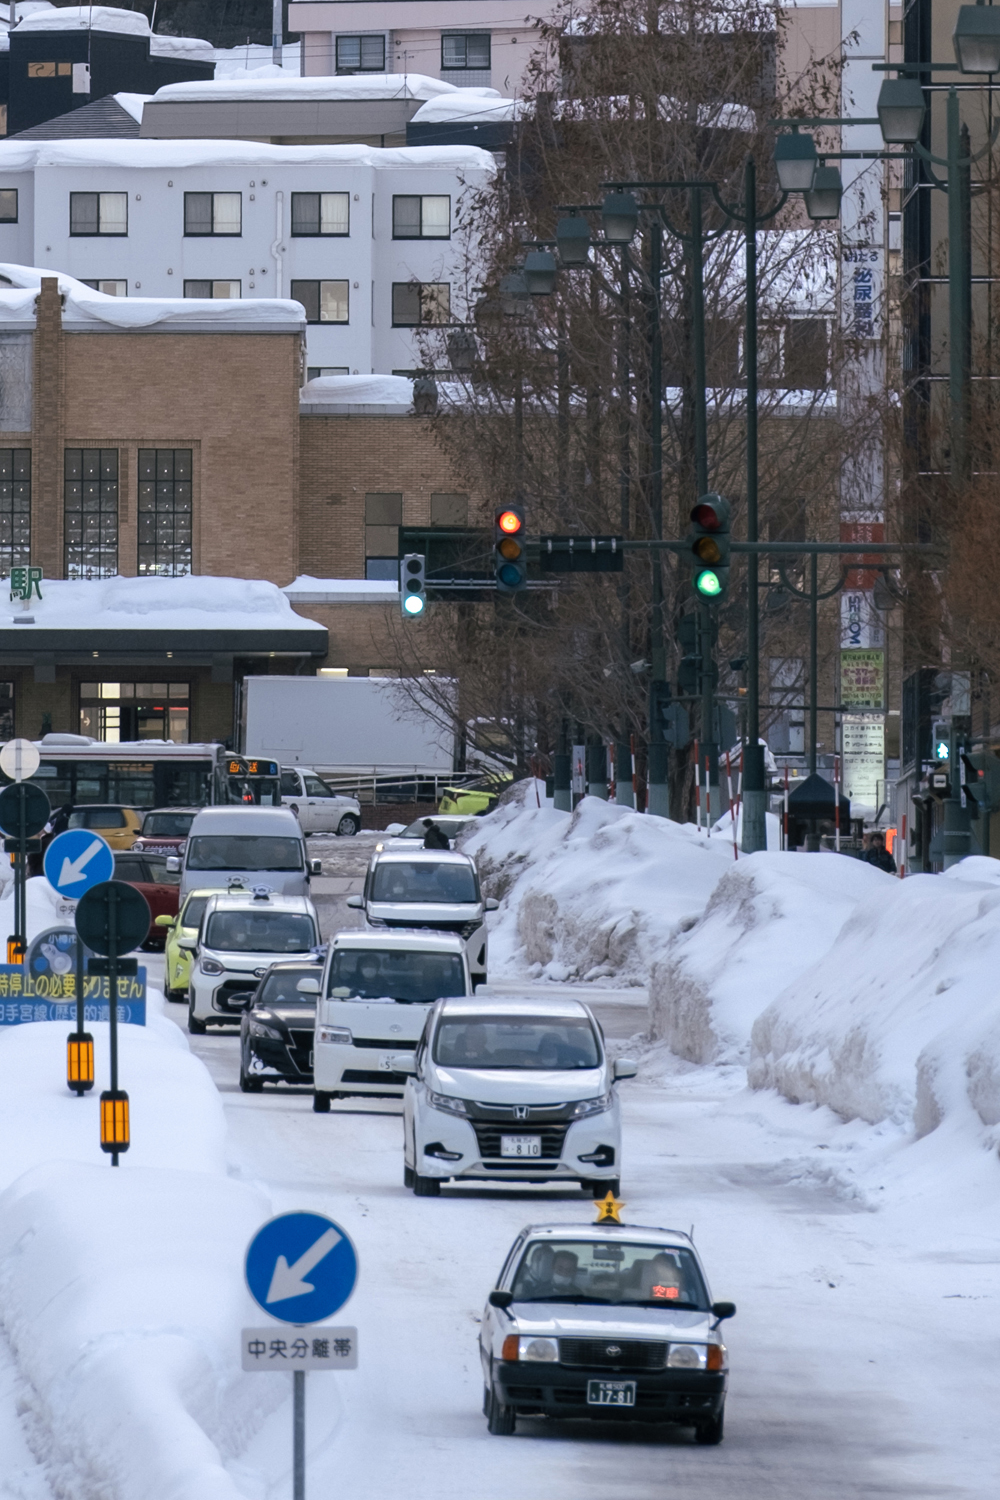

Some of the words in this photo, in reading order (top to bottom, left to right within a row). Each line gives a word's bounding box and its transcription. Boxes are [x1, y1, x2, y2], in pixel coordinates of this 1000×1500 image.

[652, 1285, 679, 1298] 空車
[248, 1338, 352, 1359] 中央分離帯
